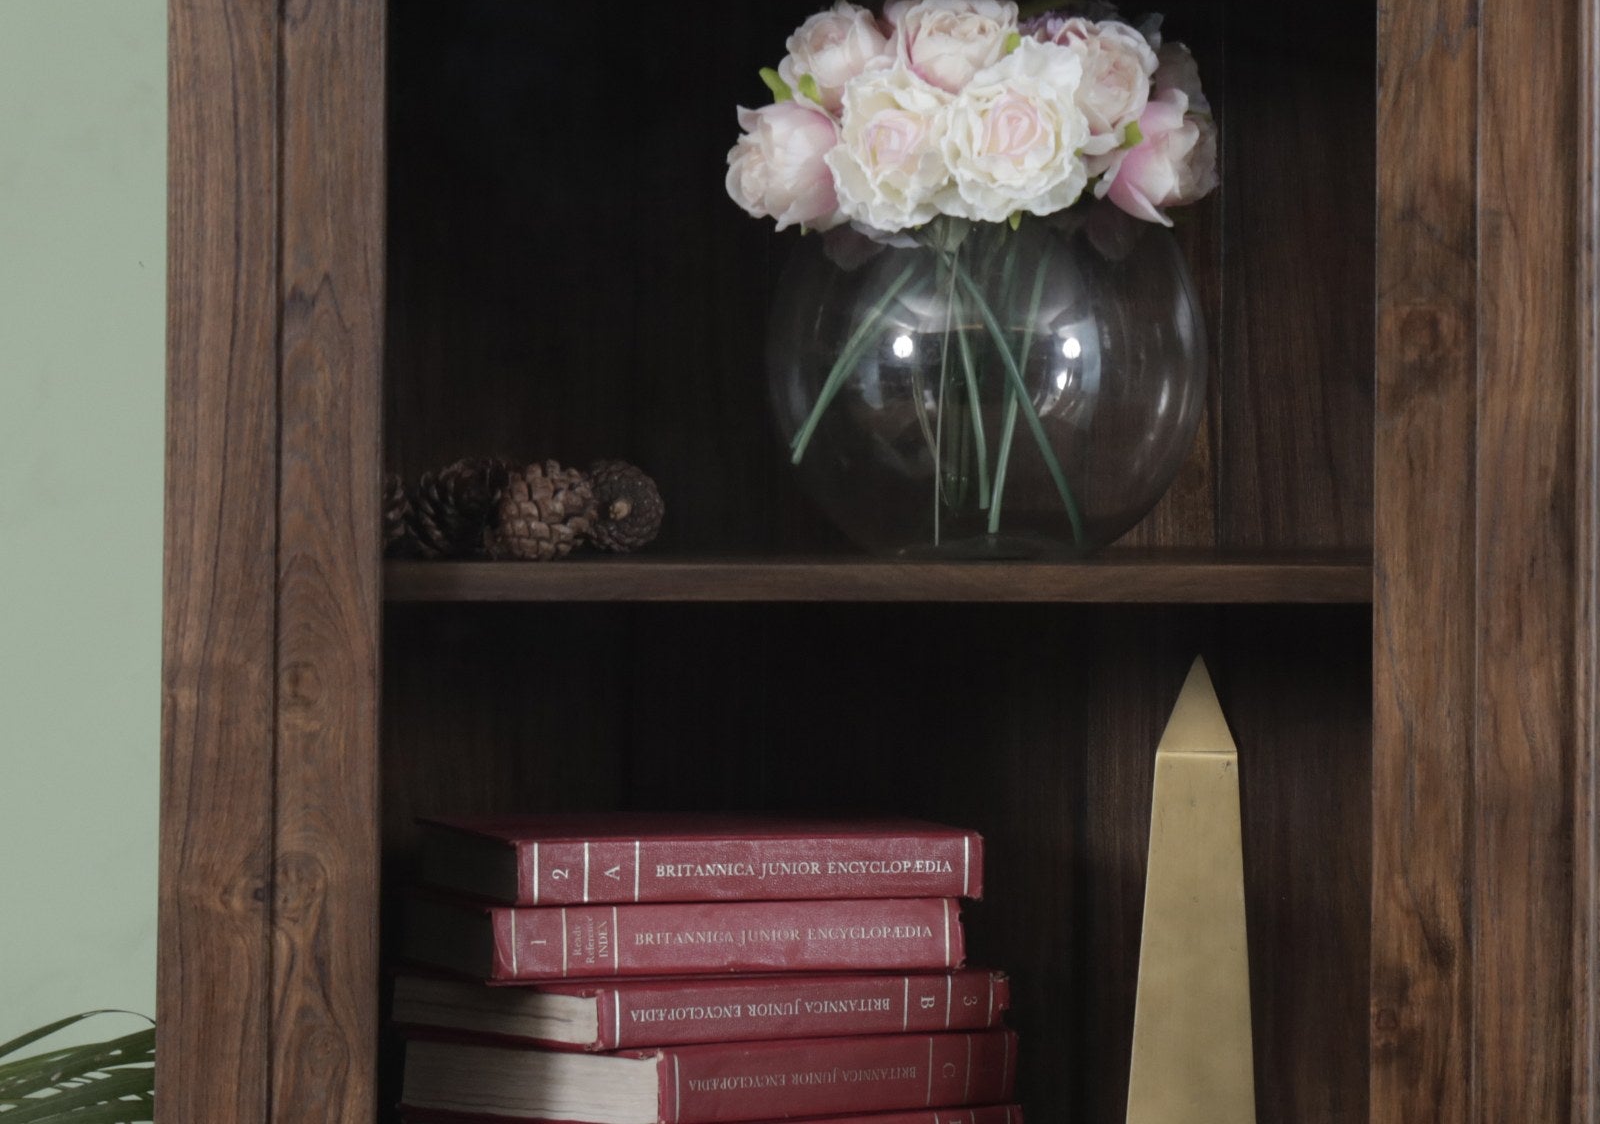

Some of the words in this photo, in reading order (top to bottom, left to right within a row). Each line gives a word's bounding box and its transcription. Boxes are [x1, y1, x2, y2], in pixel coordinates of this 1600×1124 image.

[552, 867, 569, 880] 2
[604, 865, 620, 881] A
[656, 862, 755, 878] BRITANNICA
[759, 861, 821, 880] JUNIOR
[598, 921, 609, 958] INDEX
[634, 930, 735, 946] BRITANNICA
[739, 929, 800, 946] JUNIOR
[747, 998, 801, 1017] JUNIOR
[805, 997, 890, 1014] BRITANNICA
[920, 996, 935, 1009] B
[963, 995, 978, 1006] 3
[791, 1067, 838, 1085] JUNIOR
[841, 1066, 917, 1082] BRITANNICA
[943, 1062, 956, 1079] C
